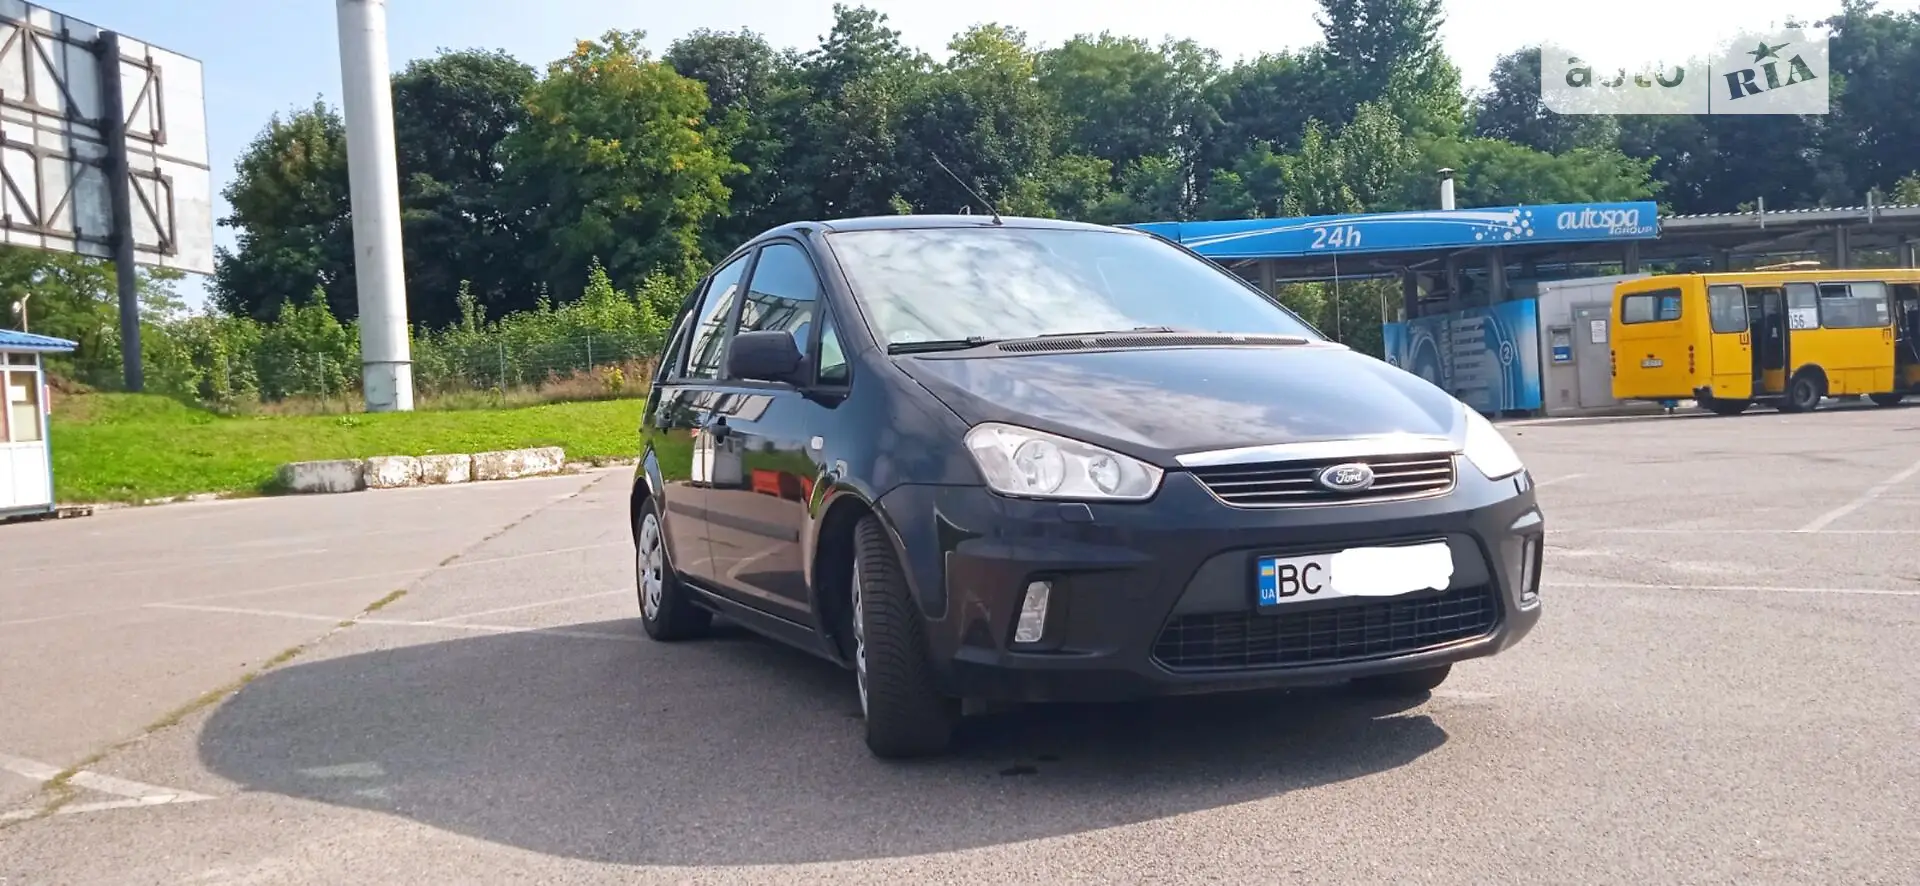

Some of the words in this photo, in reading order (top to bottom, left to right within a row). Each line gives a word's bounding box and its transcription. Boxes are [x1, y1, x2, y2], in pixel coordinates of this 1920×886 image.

[1557, 207, 1639, 235] autospa
[1311, 225, 1361, 249] 24h
[1614, 225, 1653, 236] GROUP
[1502, 345, 1511, 361] 2
[1335, 469, 1362, 484] Ford
[1279, 562, 1322, 597] BC
[1261, 588, 1276, 600] UA
